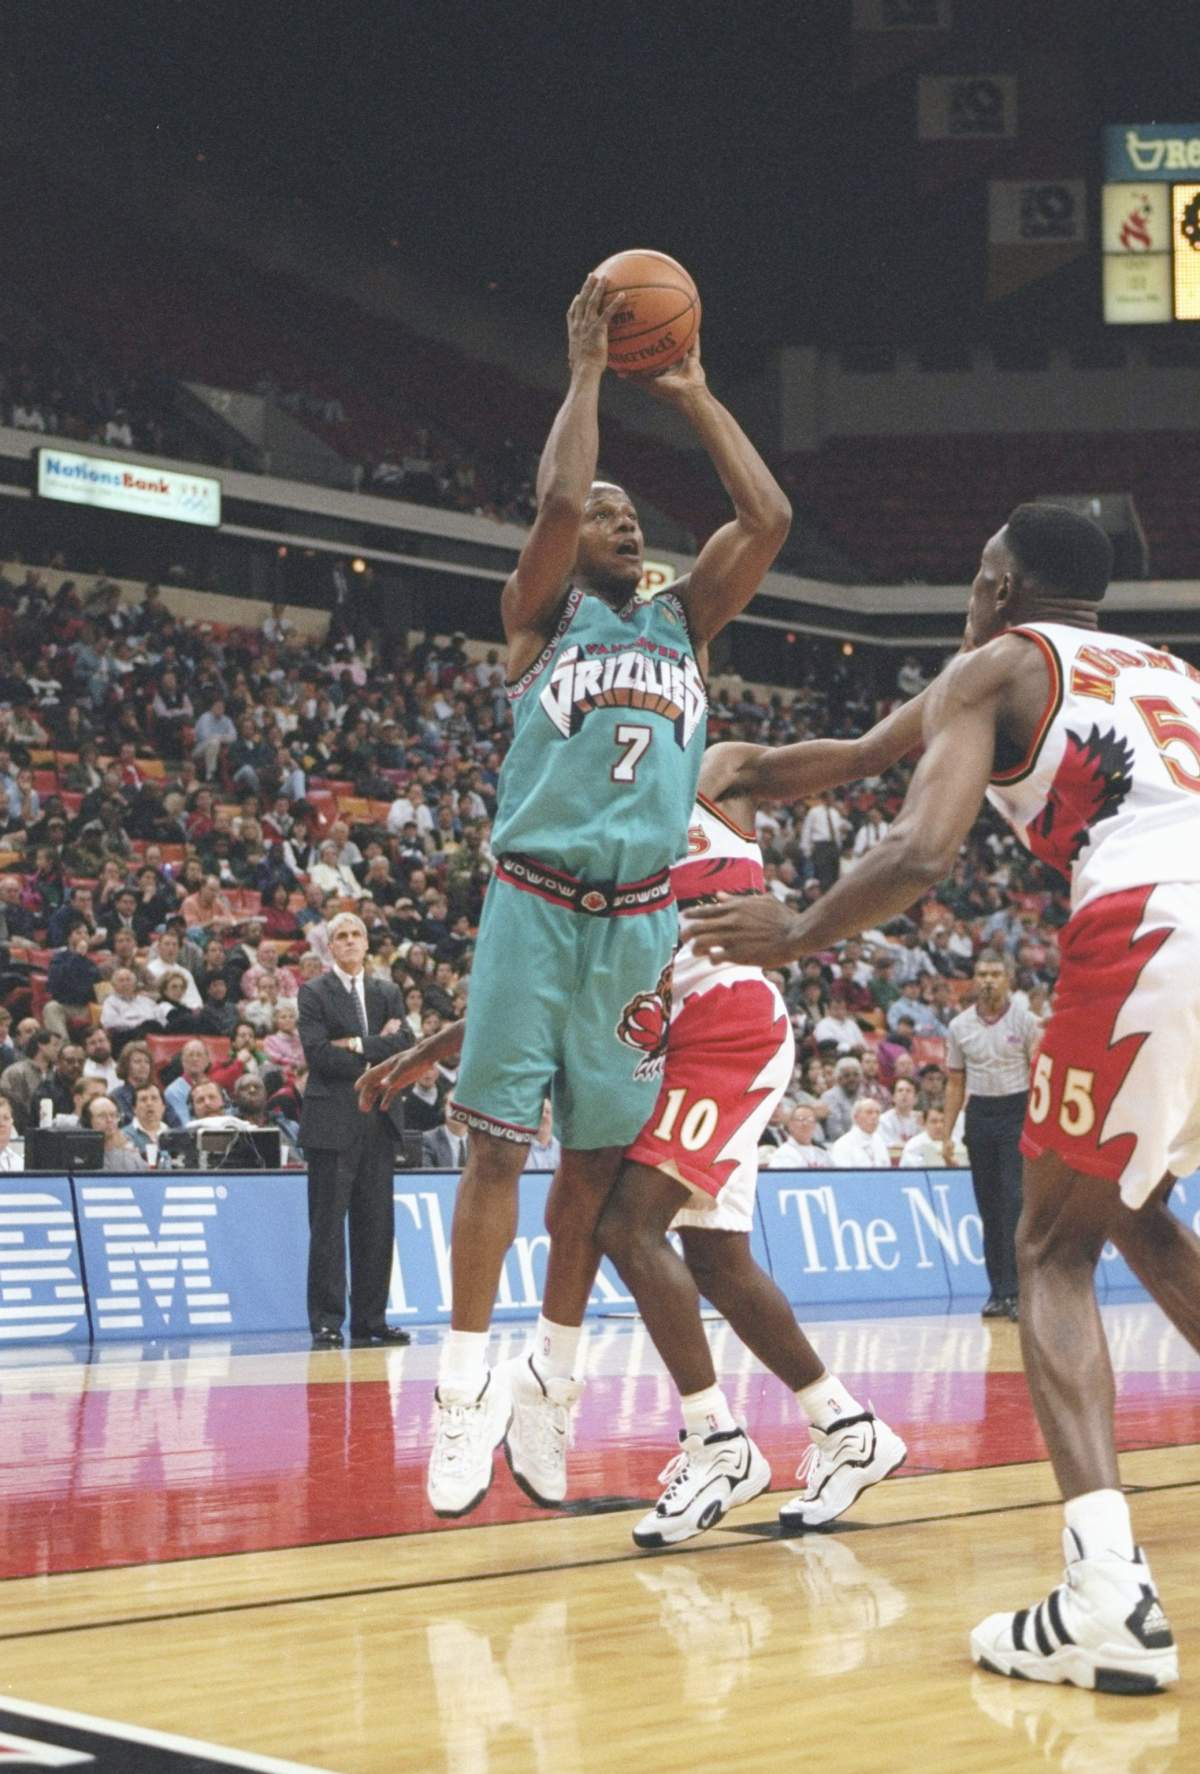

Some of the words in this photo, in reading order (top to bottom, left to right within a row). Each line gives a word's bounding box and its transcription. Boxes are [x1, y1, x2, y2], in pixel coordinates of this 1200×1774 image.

[46, 458, 169, 495] NationsBank
[610, 723, 653, 785] 7
[1130, 694, 1200, 796] 5
[652, 1086, 719, 1152] 10
[1028, 1053, 1096, 1137] 55
[778, 1185, 900, 1273] The
